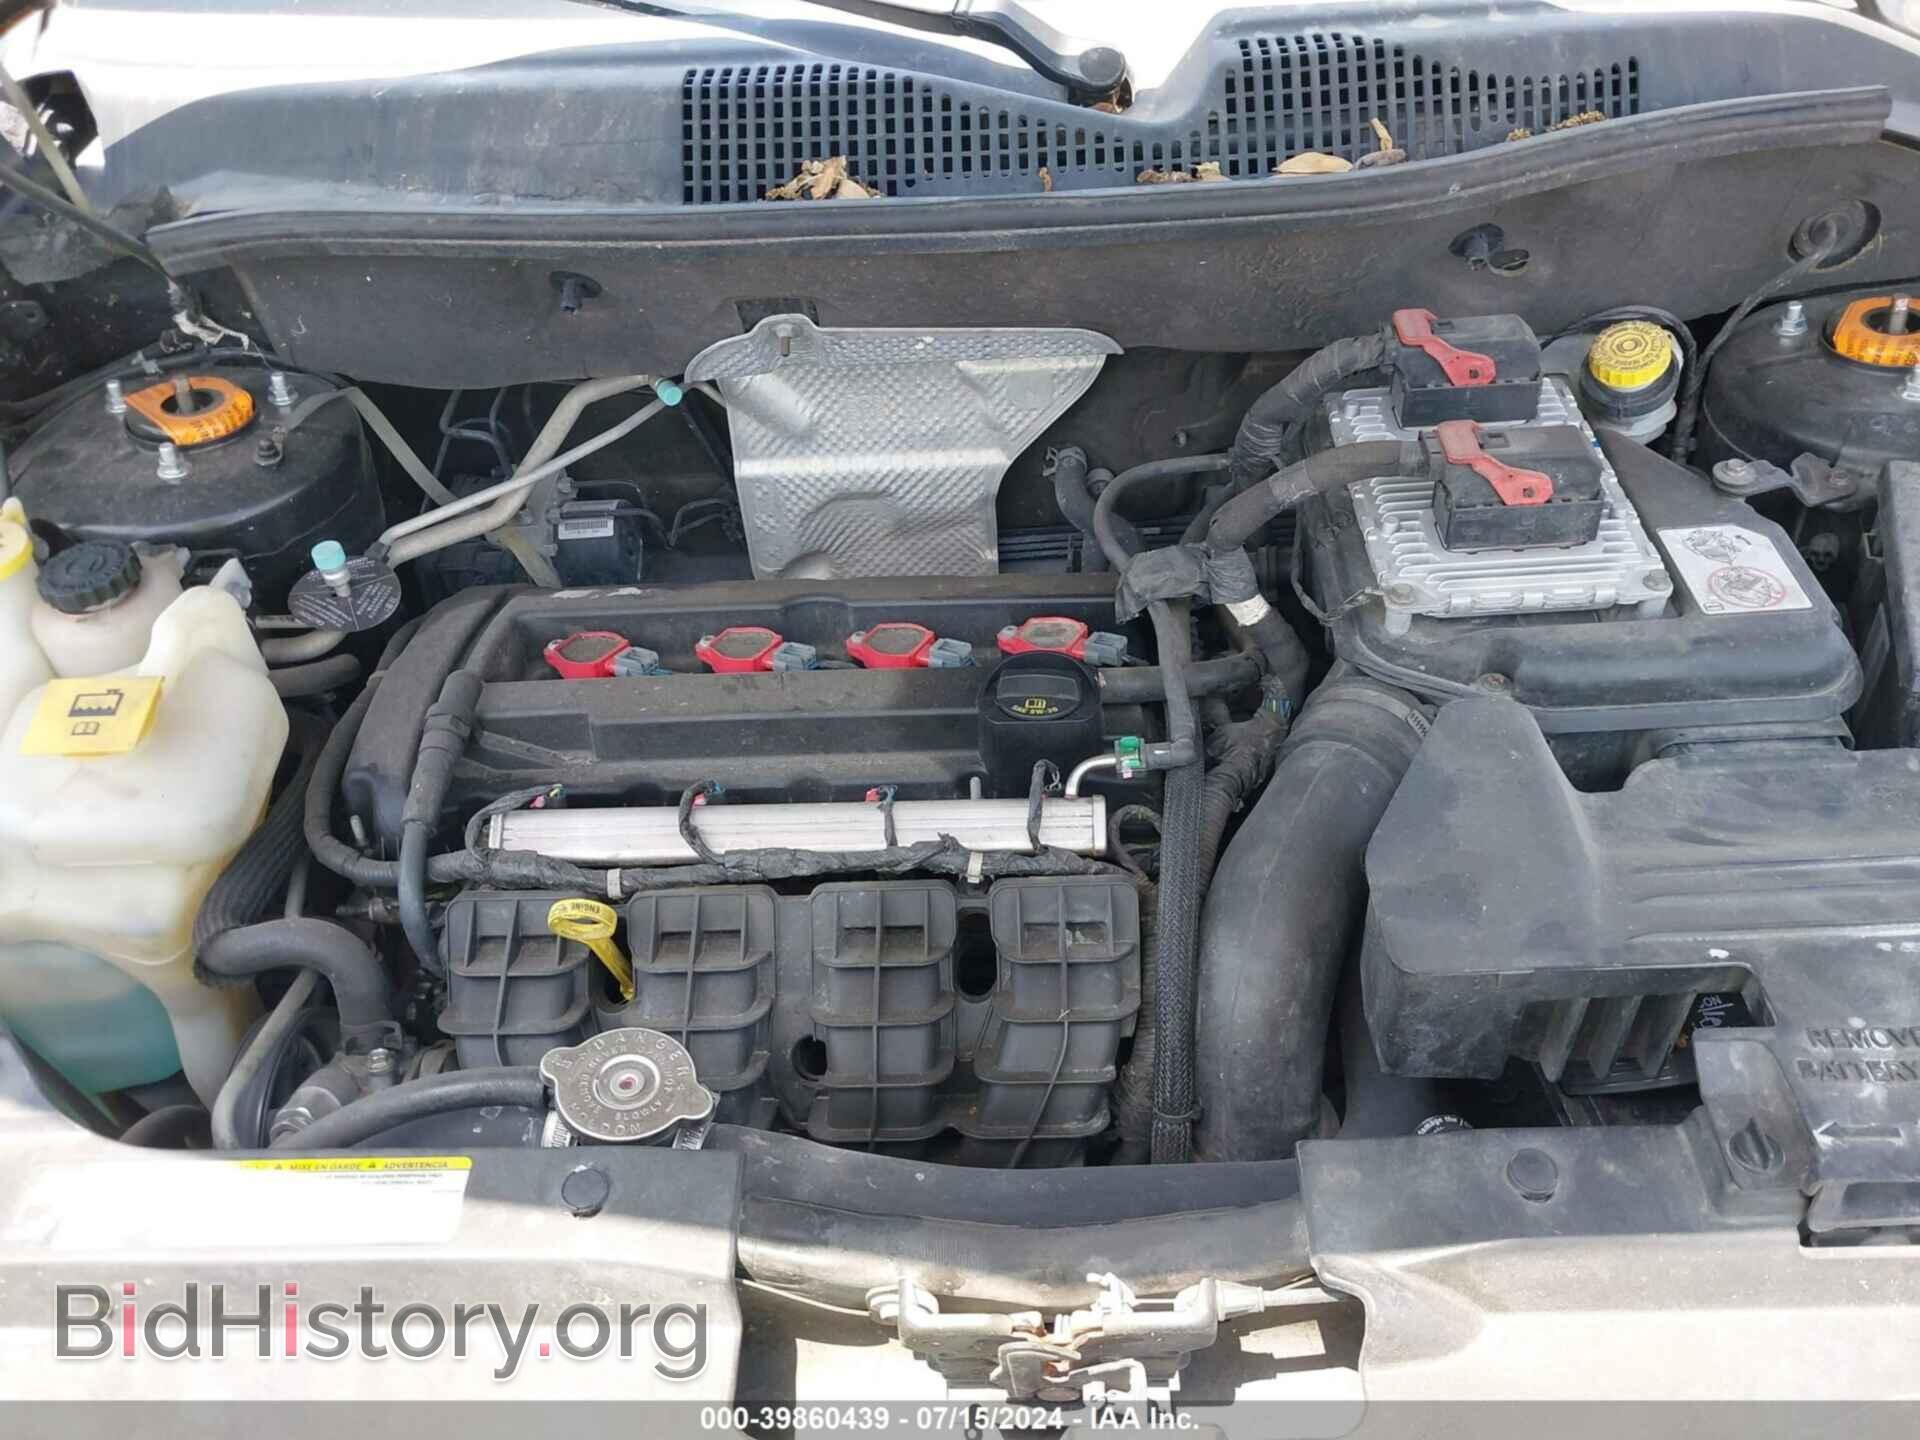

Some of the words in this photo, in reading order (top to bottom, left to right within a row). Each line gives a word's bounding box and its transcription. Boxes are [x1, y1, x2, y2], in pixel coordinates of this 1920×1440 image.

[593, 1031, 691, 1077] DANGER
[1796, 1059, 1919, 1081] BATTERY
[613, 1100, 663, 1121] SLOWLY
[383, 1161, 449, 1169] ADVERTENCIA
